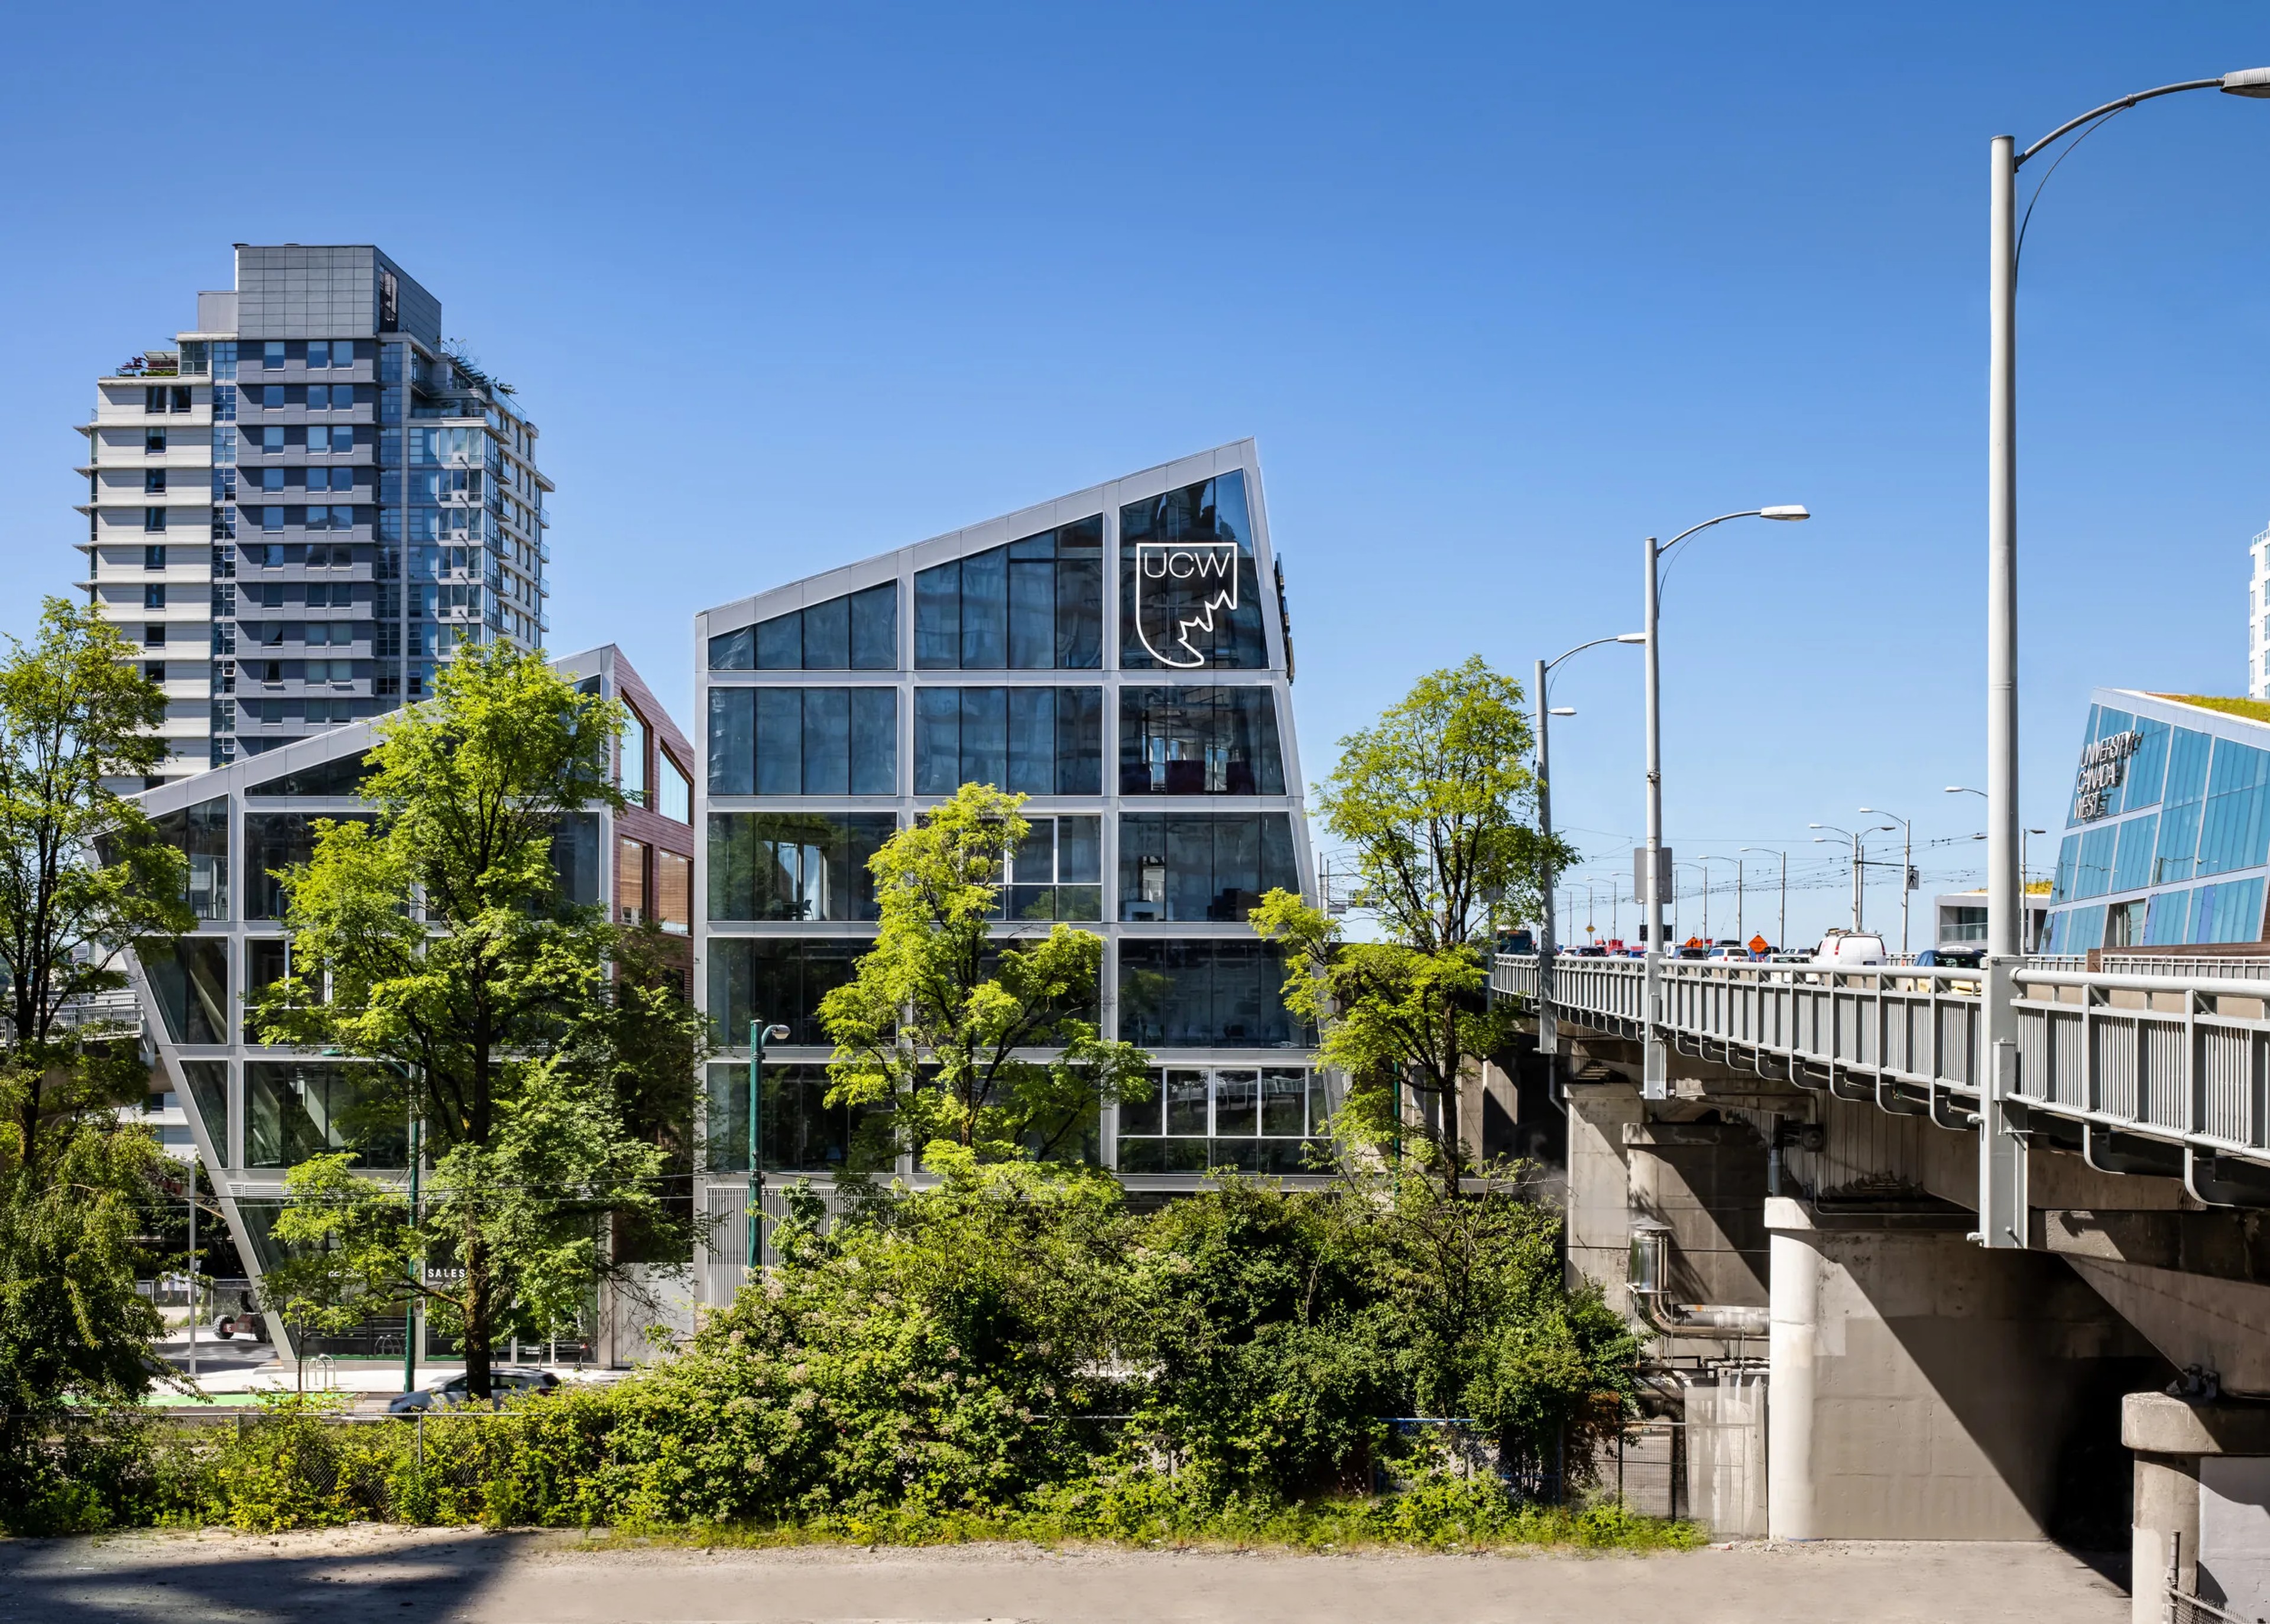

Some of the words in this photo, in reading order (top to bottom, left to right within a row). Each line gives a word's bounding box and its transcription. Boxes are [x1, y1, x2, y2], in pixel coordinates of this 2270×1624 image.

[1144, 551, 1231, 579] UCW
[2077, 761, 2116, 794] CANADA
[2073, 791, 2100, 820] WEST
[427, 1268, 465, 1278] SALES
